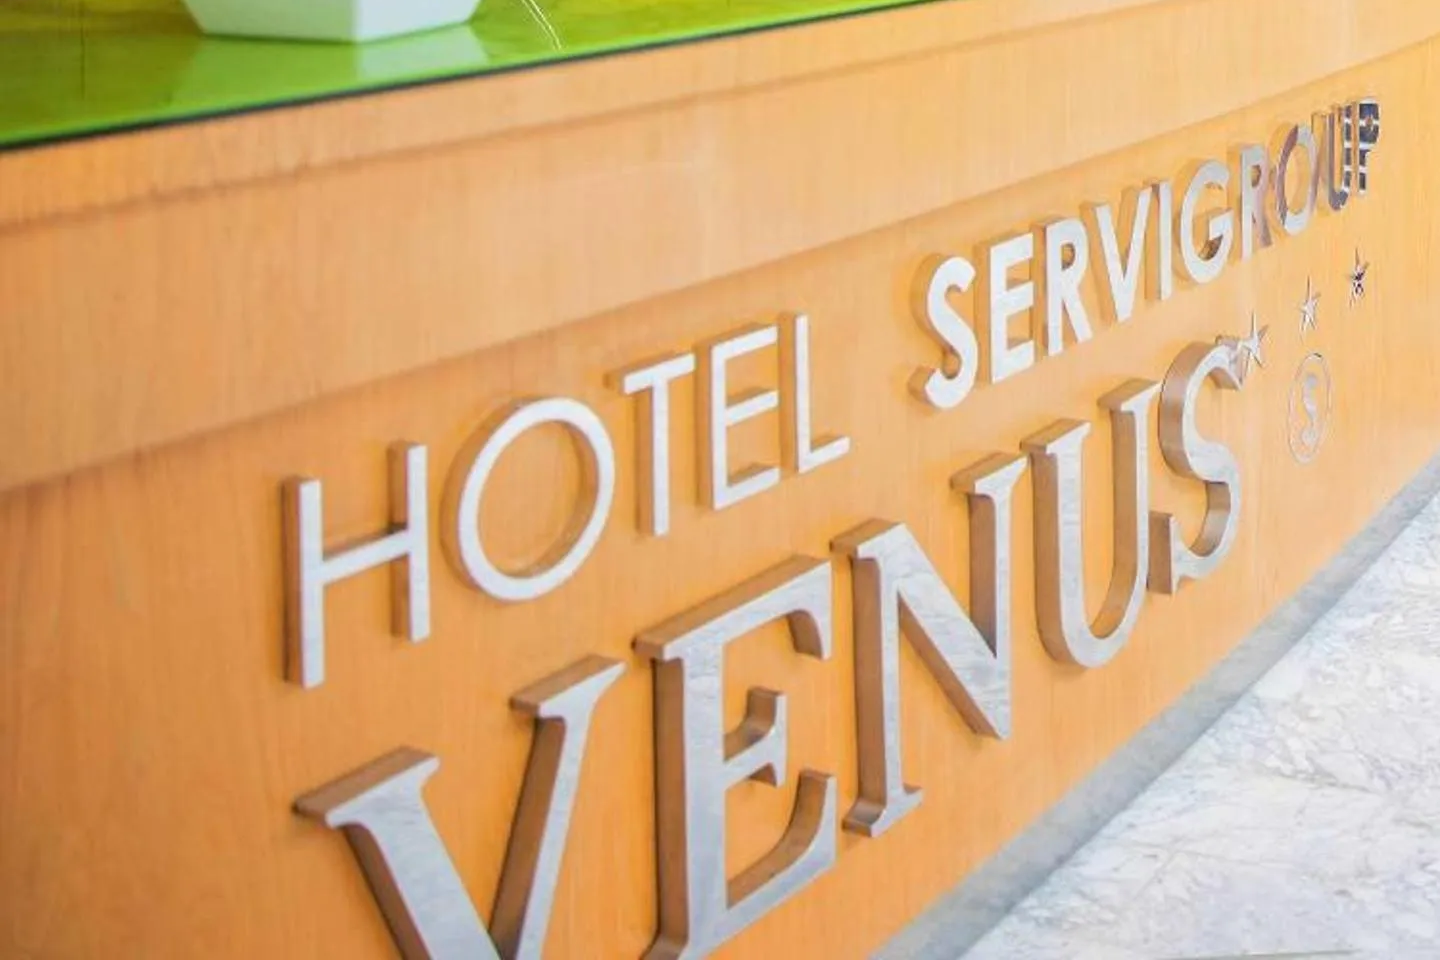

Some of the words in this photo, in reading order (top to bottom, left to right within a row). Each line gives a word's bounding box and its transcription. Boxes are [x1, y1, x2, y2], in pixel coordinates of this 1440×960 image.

[283, 312, 850, 690] HOTEL
[910, 96, 1381, 410] SERVIGROUP
[296, 340, 1244, 960] VENUS
